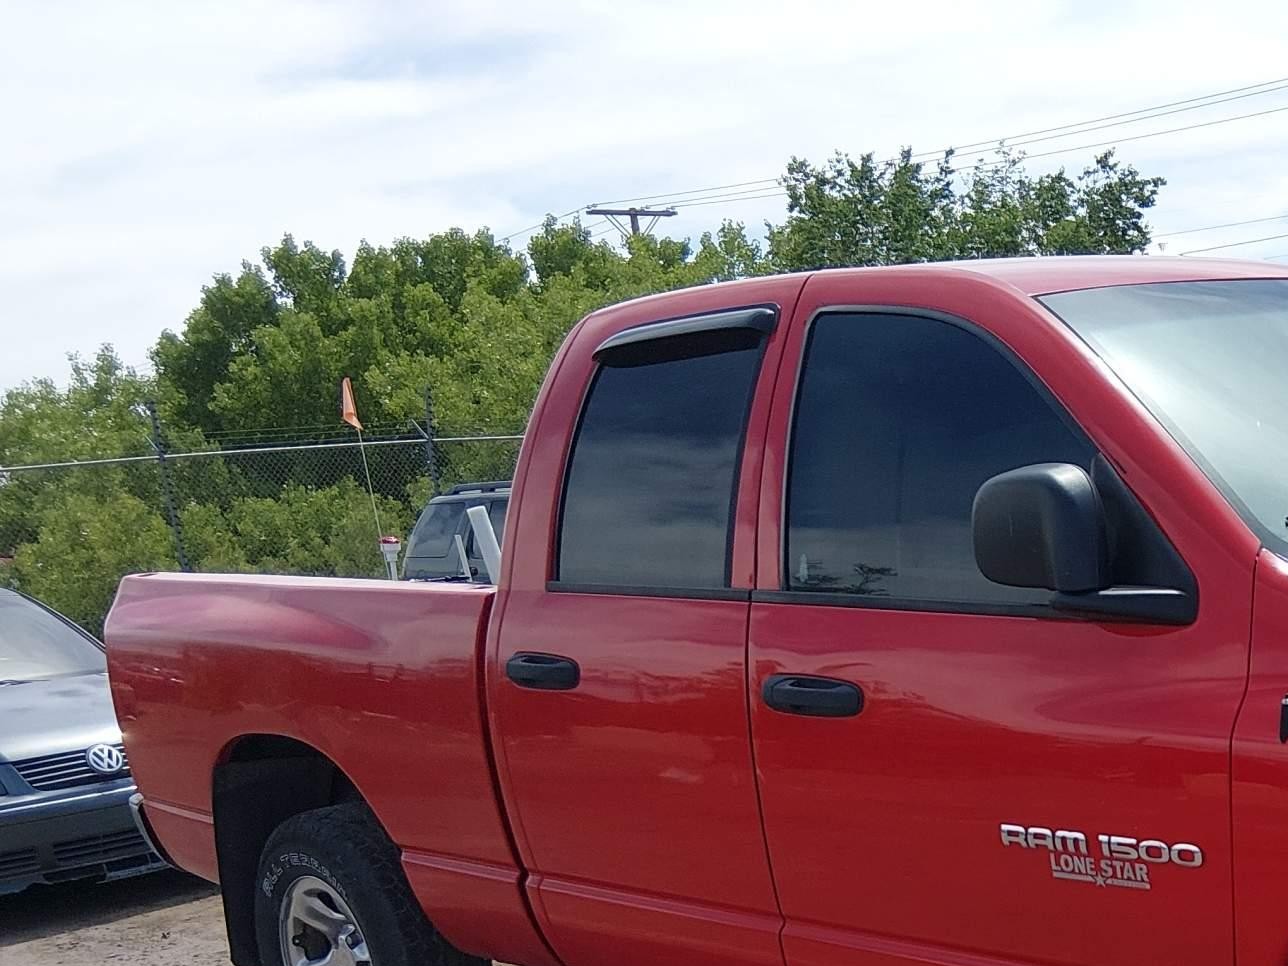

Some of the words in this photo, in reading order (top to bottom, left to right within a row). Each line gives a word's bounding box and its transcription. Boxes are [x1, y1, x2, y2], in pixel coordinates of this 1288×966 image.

[1000, 823, 1088, 853] RAM
[1098, 834, 1203, 867] 1500
[1050, 853, 1096, 875] LONE
[1100, 859, 1149, 882] STAR
